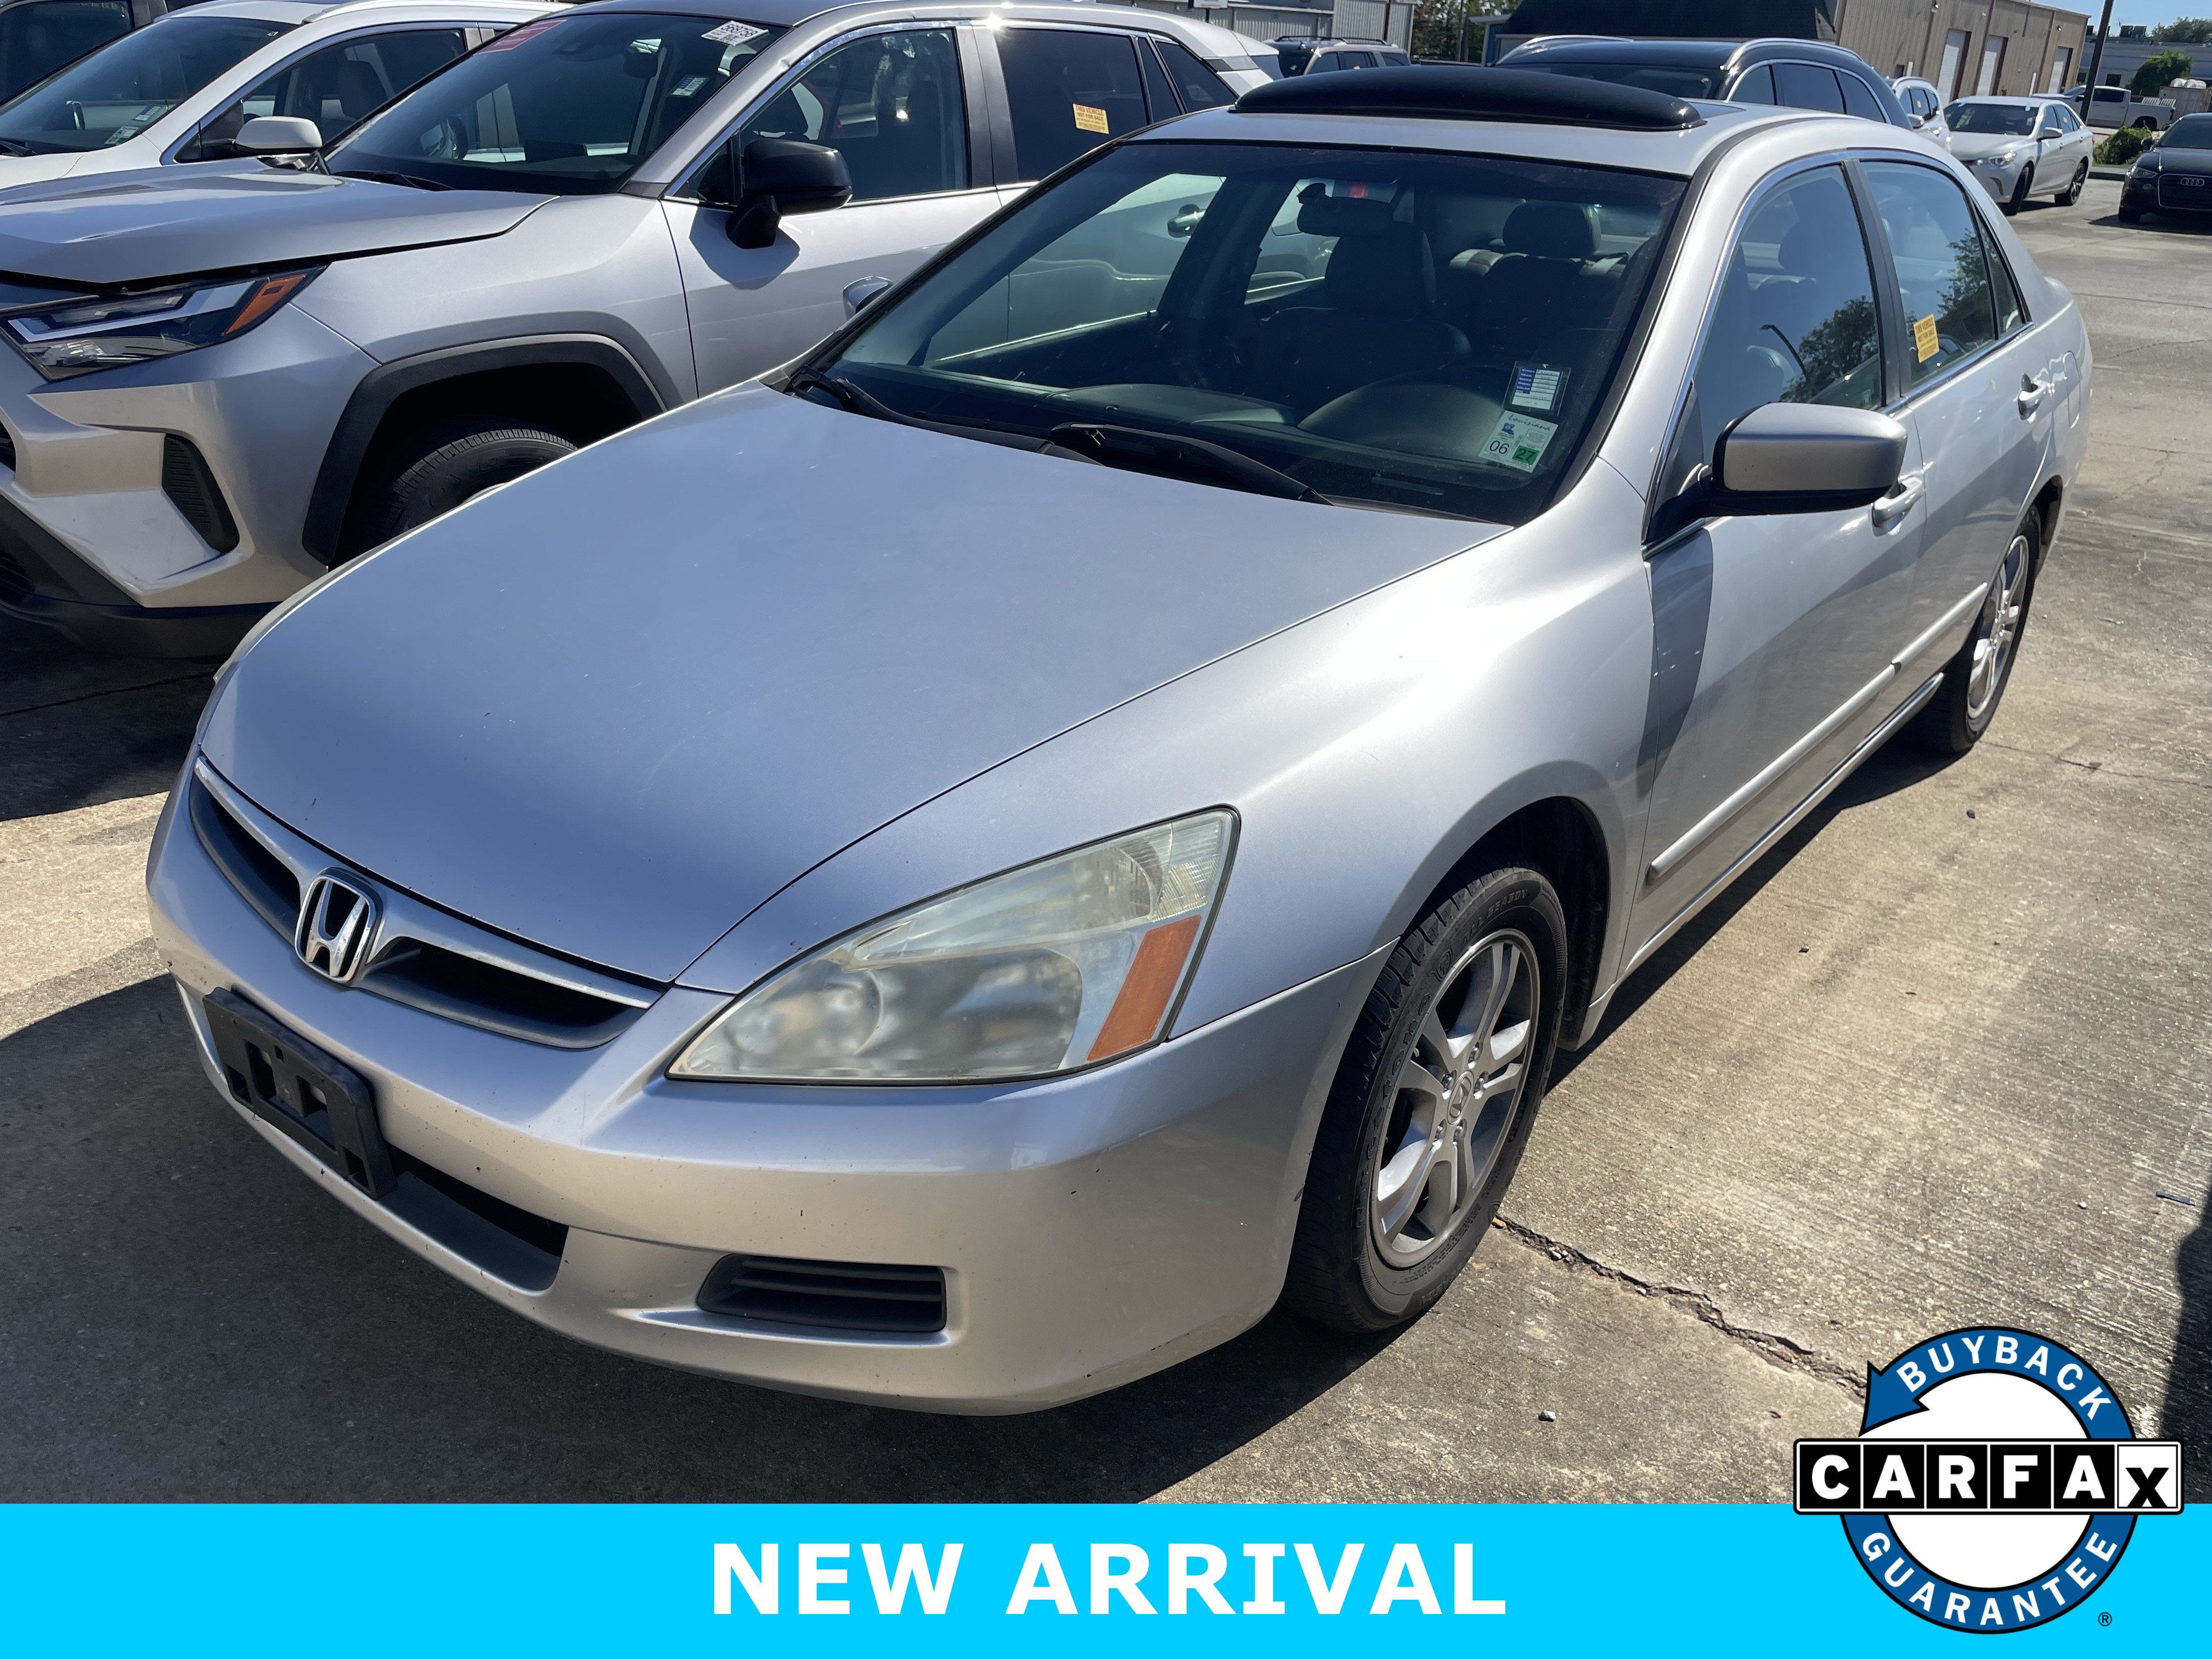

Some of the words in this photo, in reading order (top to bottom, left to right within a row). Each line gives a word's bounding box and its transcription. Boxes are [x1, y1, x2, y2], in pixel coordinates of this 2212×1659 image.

[1489, 440, 1510, 454] 06
[1515, 448, 1536, 460] 27
[1487, 888, 1528, 919] SEASON
